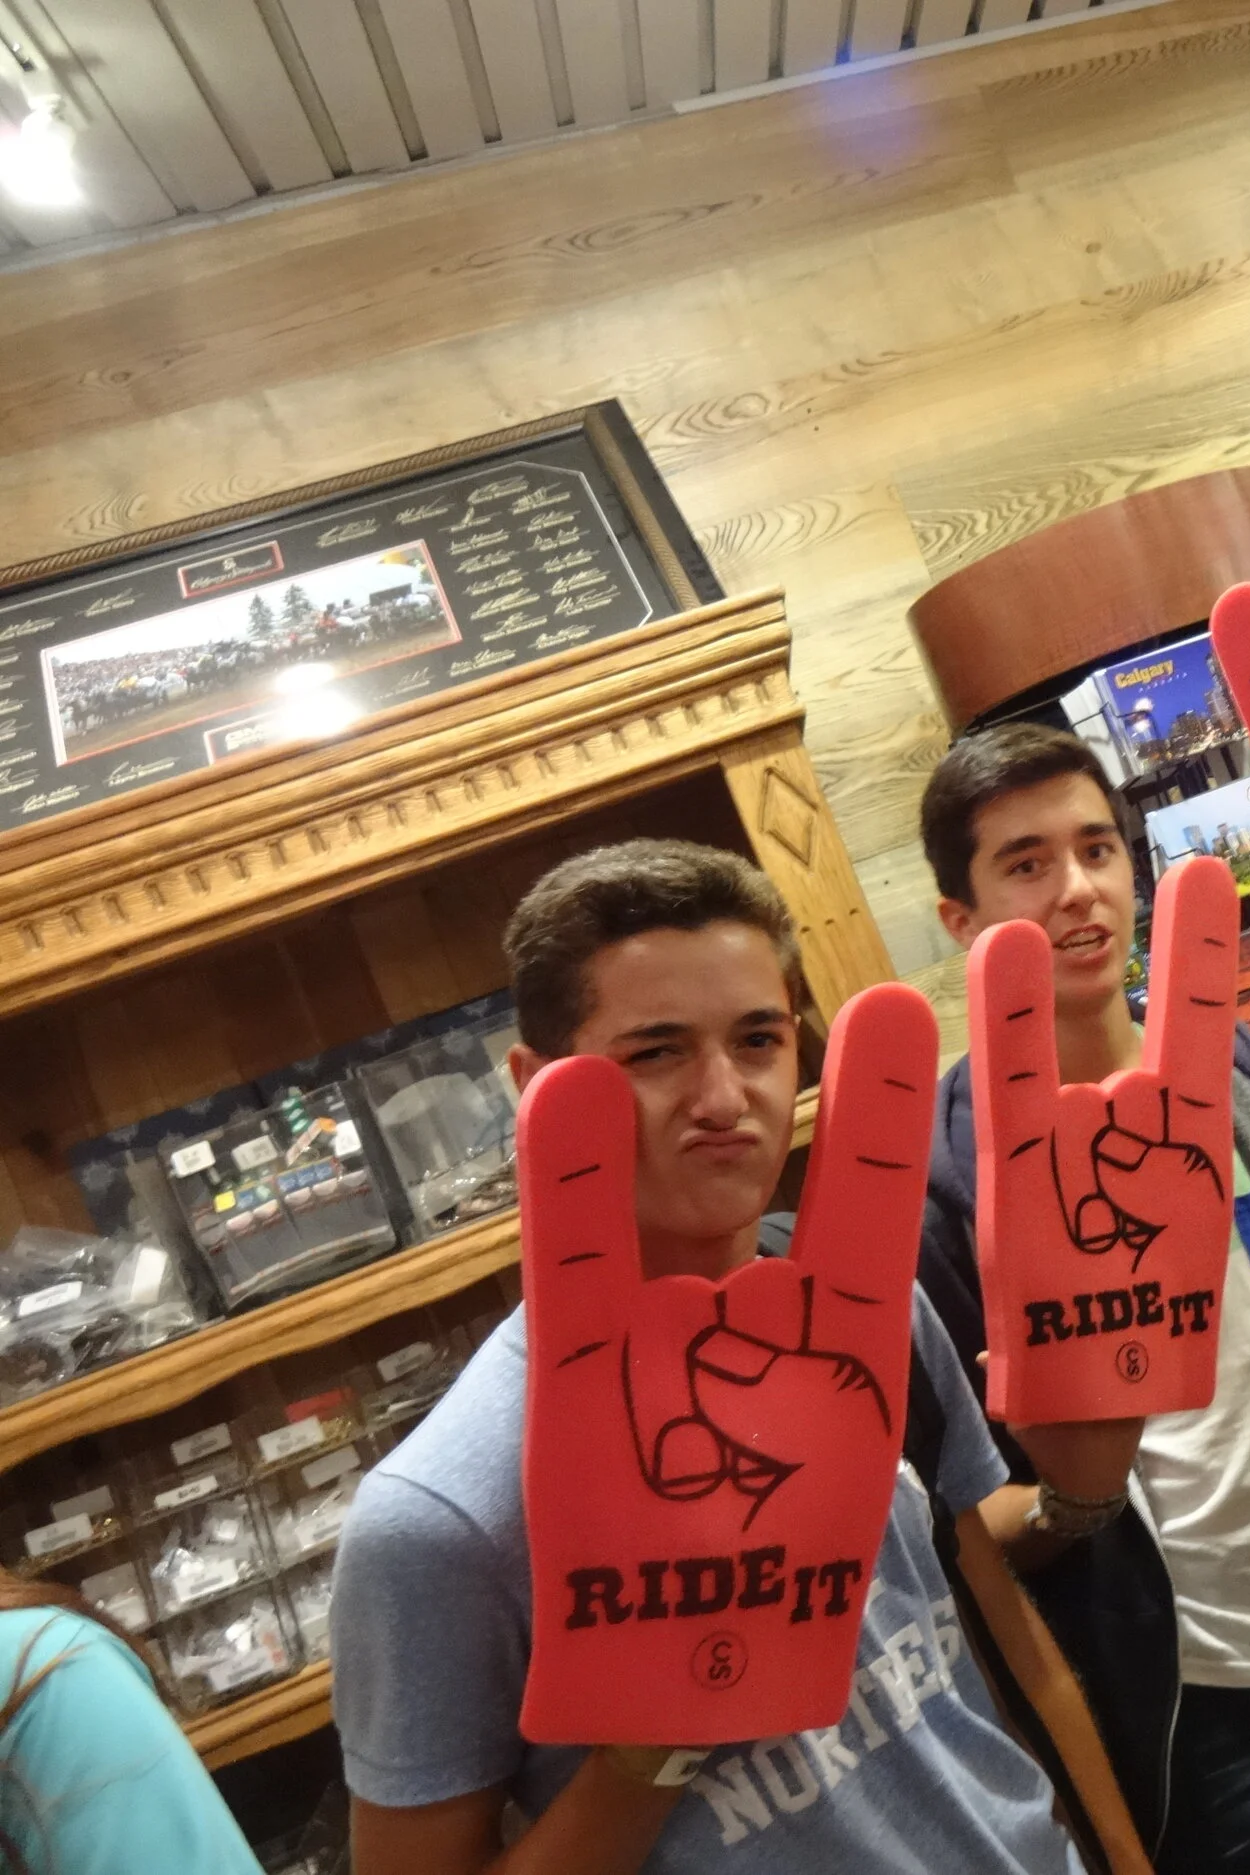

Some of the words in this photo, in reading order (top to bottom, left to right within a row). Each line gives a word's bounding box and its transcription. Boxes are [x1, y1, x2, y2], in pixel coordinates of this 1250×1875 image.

[1114, 660, 1174, 690] Calgary
[1024, 1281, 1165, 1347] RIDE
[1169, 1289, 1214, 1337] IT
[565, 1544, 787, 1630] RIDE
[789, 1559, 862, 1625] IT
